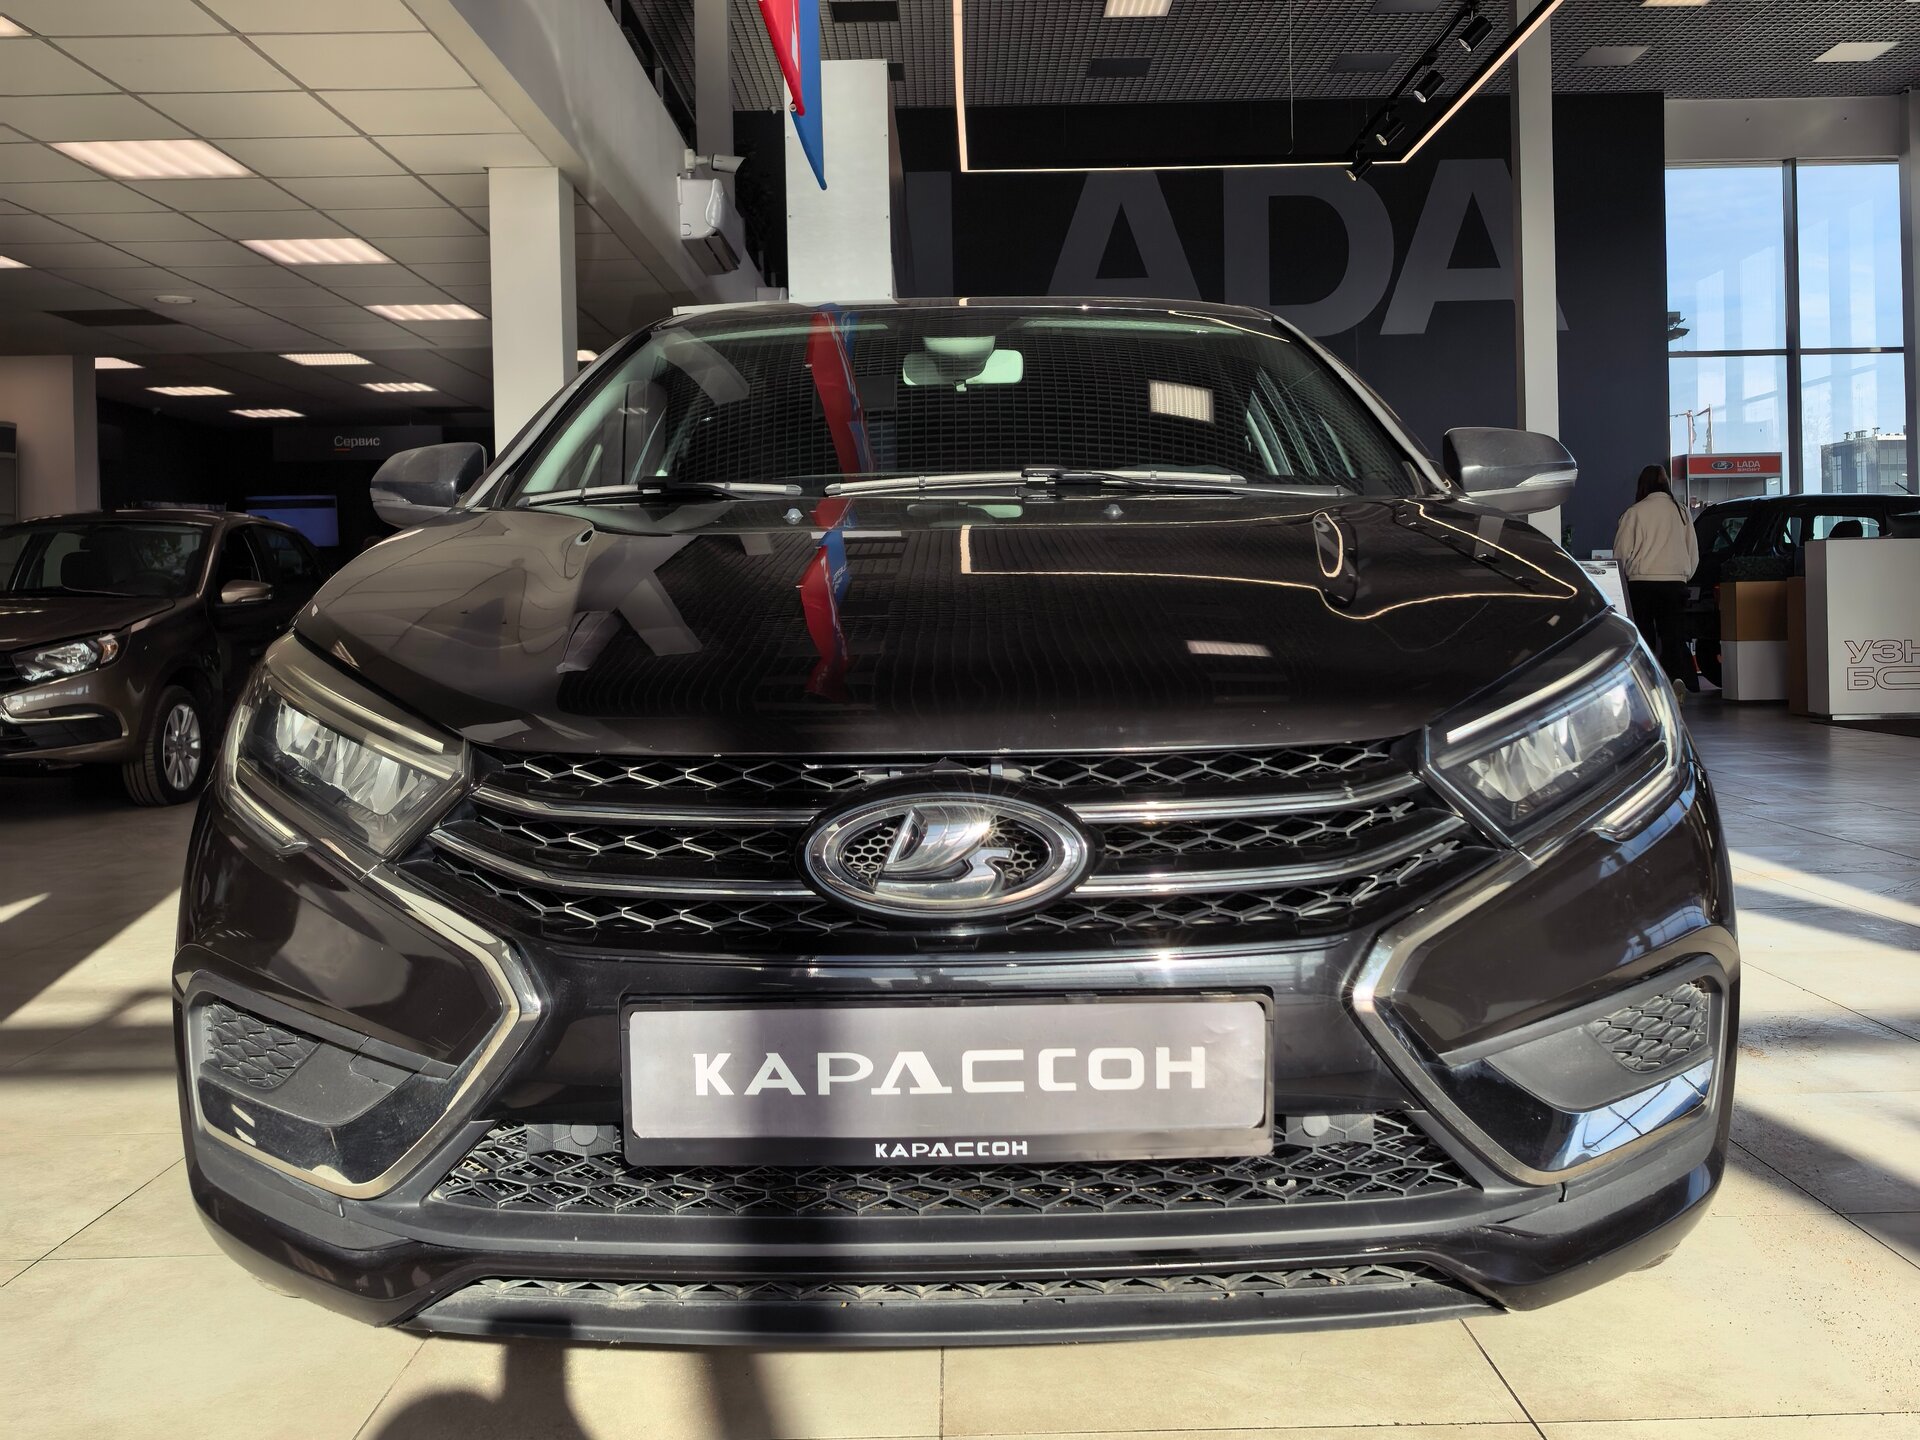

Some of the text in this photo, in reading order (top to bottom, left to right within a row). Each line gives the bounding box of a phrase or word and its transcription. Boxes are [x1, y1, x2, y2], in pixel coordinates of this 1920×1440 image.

[334, 435, 381, 449] Сервис
[1736, 460, 1761, 468] LADA
[692, 1045, 1207, 1096] КАРЛССОН
[874, 1140, 1029, 1158] КАРЛССОН
